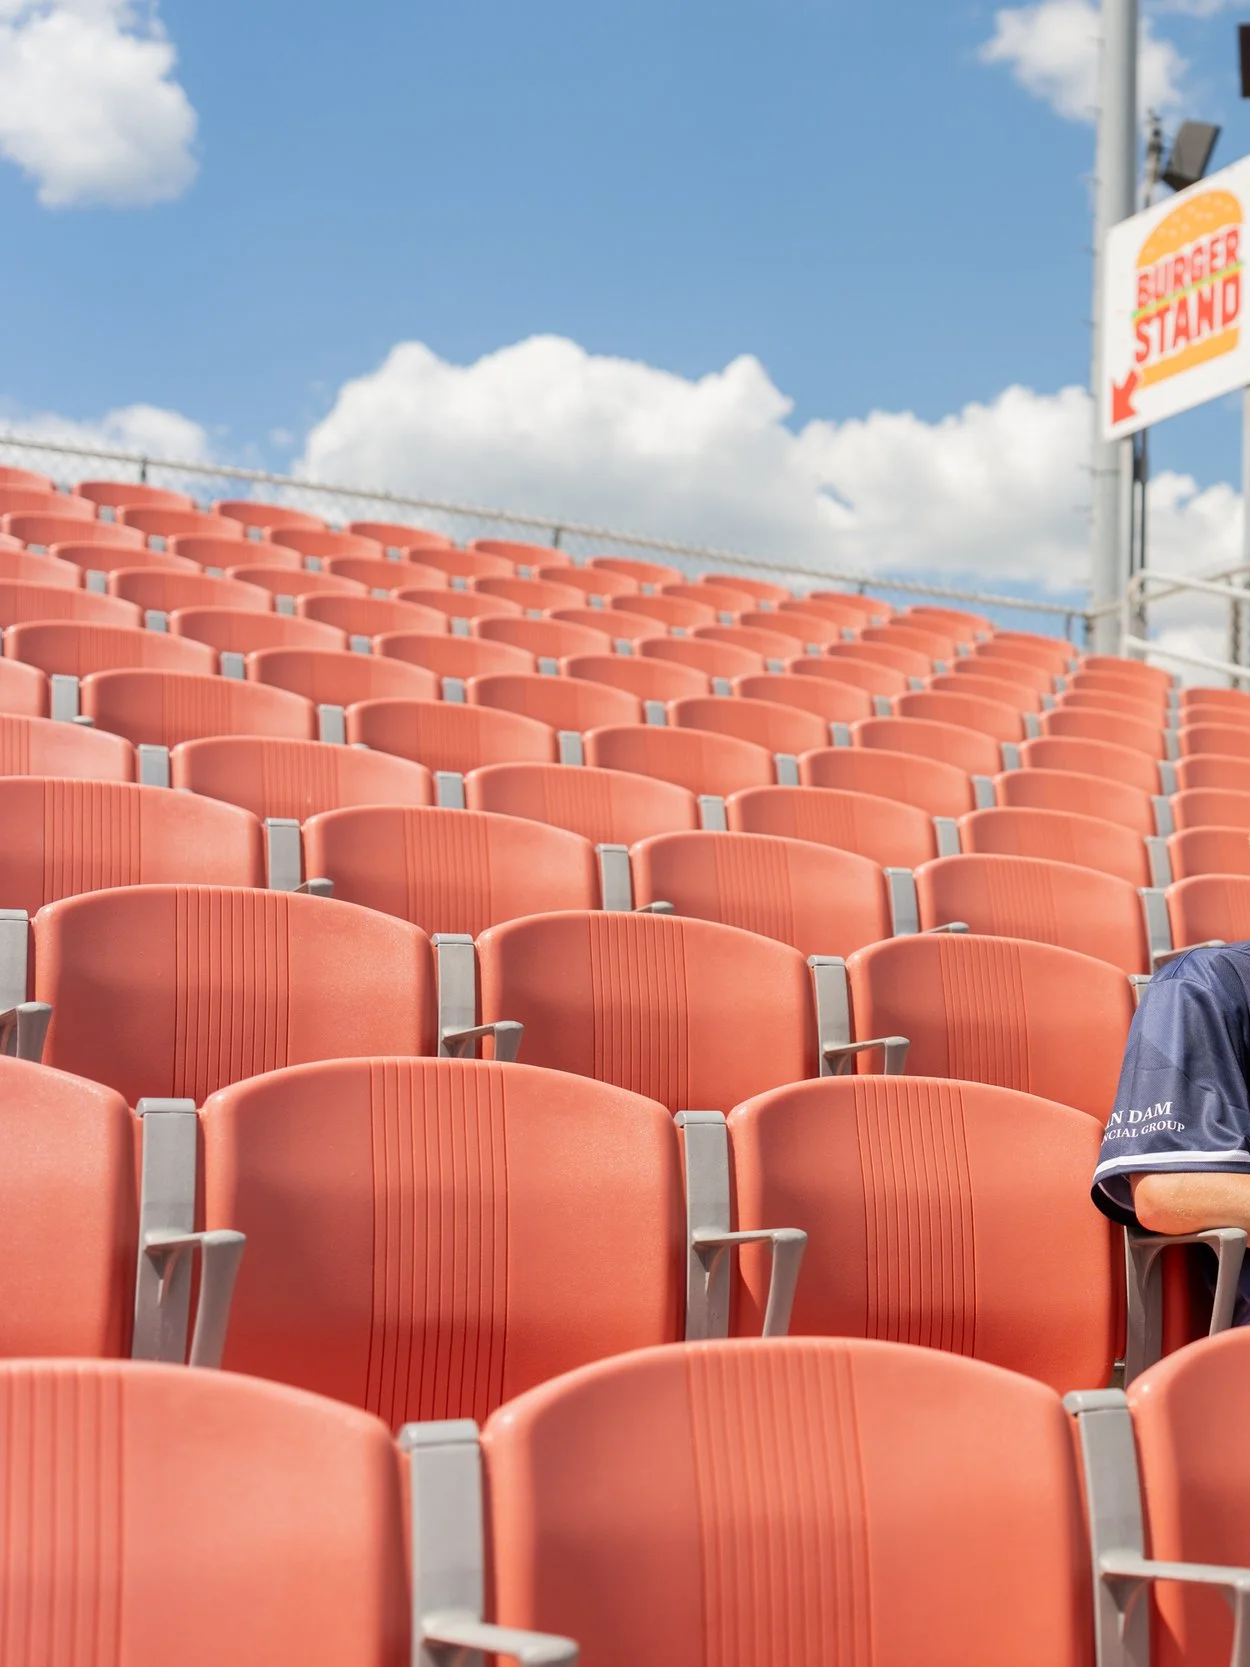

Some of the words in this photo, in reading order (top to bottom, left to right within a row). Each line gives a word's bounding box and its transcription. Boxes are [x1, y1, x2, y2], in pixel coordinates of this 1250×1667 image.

[1136, 229, 1240, 309] BURGER
[1135, 274, 1240, 364] STAND
[1127, 1101, 1173, 1124] DAM
[1141, 1120, 1185, 1135] GROUP
